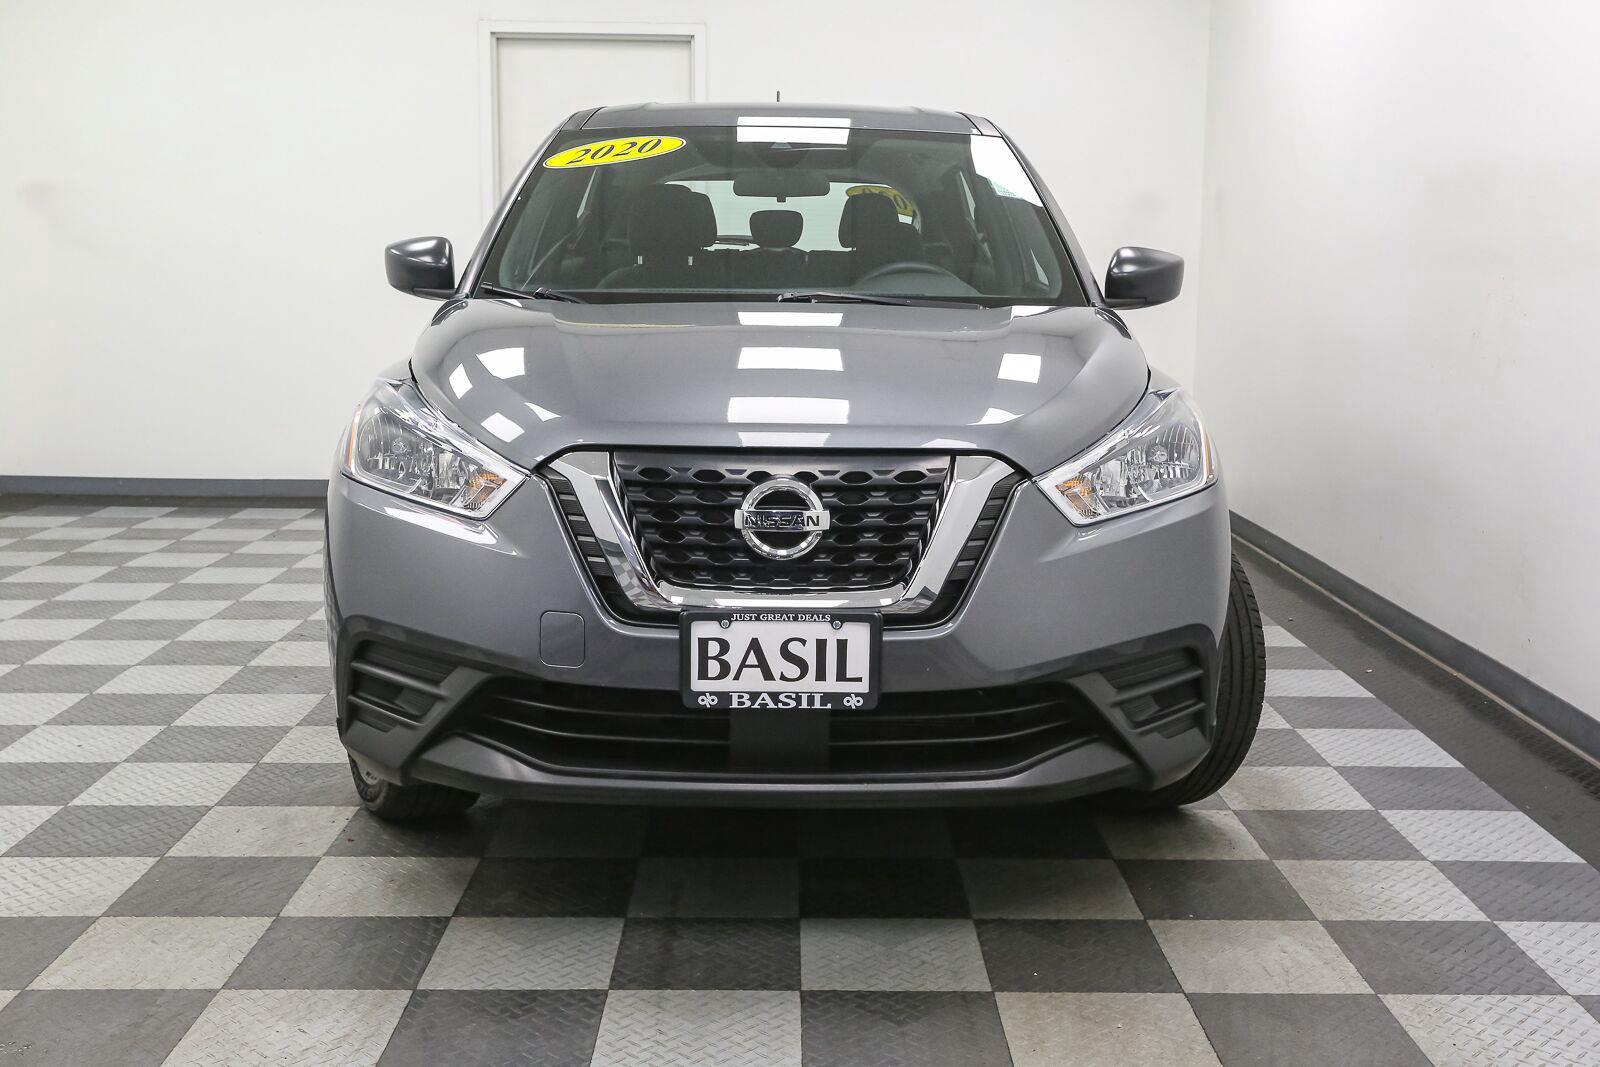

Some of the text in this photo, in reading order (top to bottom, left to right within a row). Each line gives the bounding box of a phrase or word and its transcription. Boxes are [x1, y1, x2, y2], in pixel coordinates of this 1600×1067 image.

[567, 138, 662, 164] 2020
[744, 513, 820, 527] NISSAN
[731, 613, 831, 622] JUST GREAT DEALS
[697, 637, 863, 682] BASIL
[729, 692, 832, 709] BASIL
